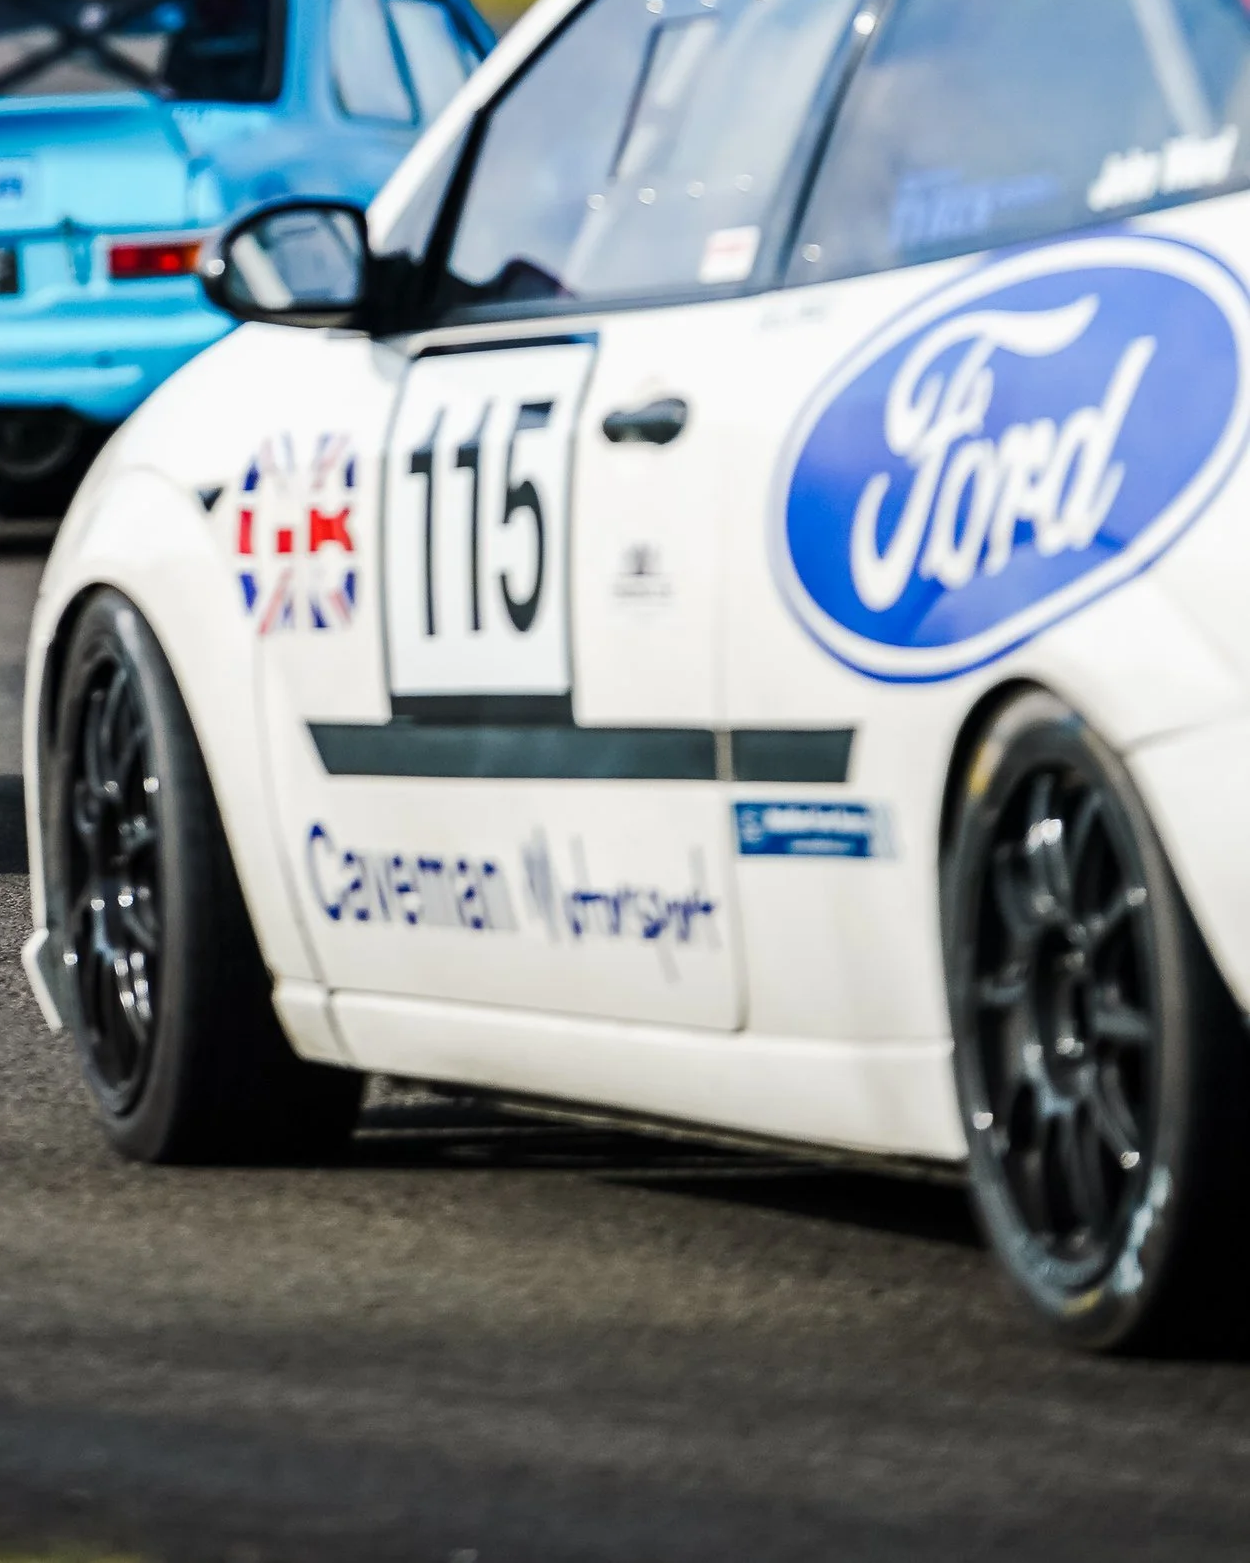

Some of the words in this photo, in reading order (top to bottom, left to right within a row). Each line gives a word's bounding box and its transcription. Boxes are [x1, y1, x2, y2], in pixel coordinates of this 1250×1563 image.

[409, 400, 553, 635] 115
[851, 295, 1156, 611] Ford
[306, 821, 518, 931] Caveman
